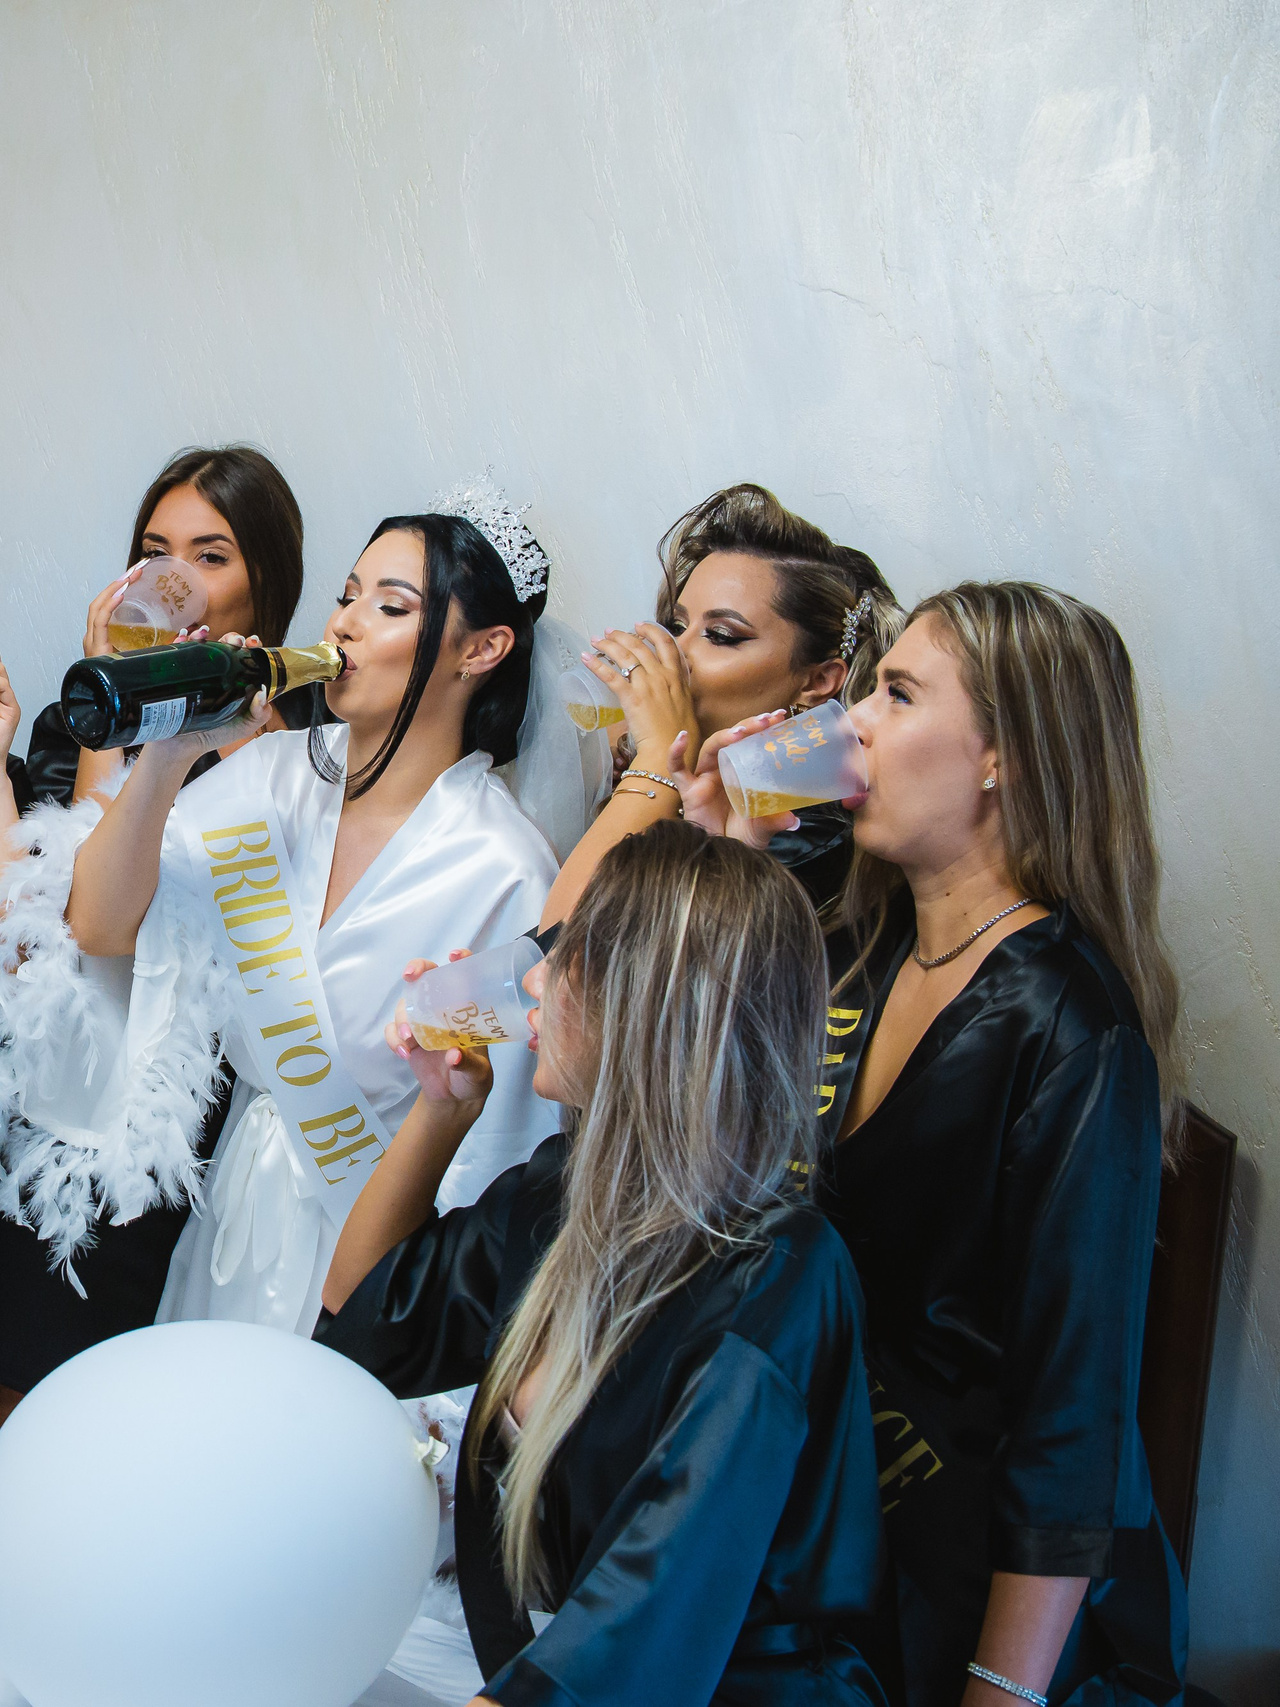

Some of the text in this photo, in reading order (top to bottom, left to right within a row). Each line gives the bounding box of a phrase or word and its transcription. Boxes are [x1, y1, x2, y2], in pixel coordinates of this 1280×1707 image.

[156, 575, 185, 612] Bride
[170, 571, 192, 596] TEAM
[799, 715, 828, 747] TEAM
[201, 820, 387, 1186] BRIDE TO BE
[482, 1006, 509, 1039] TEAM
